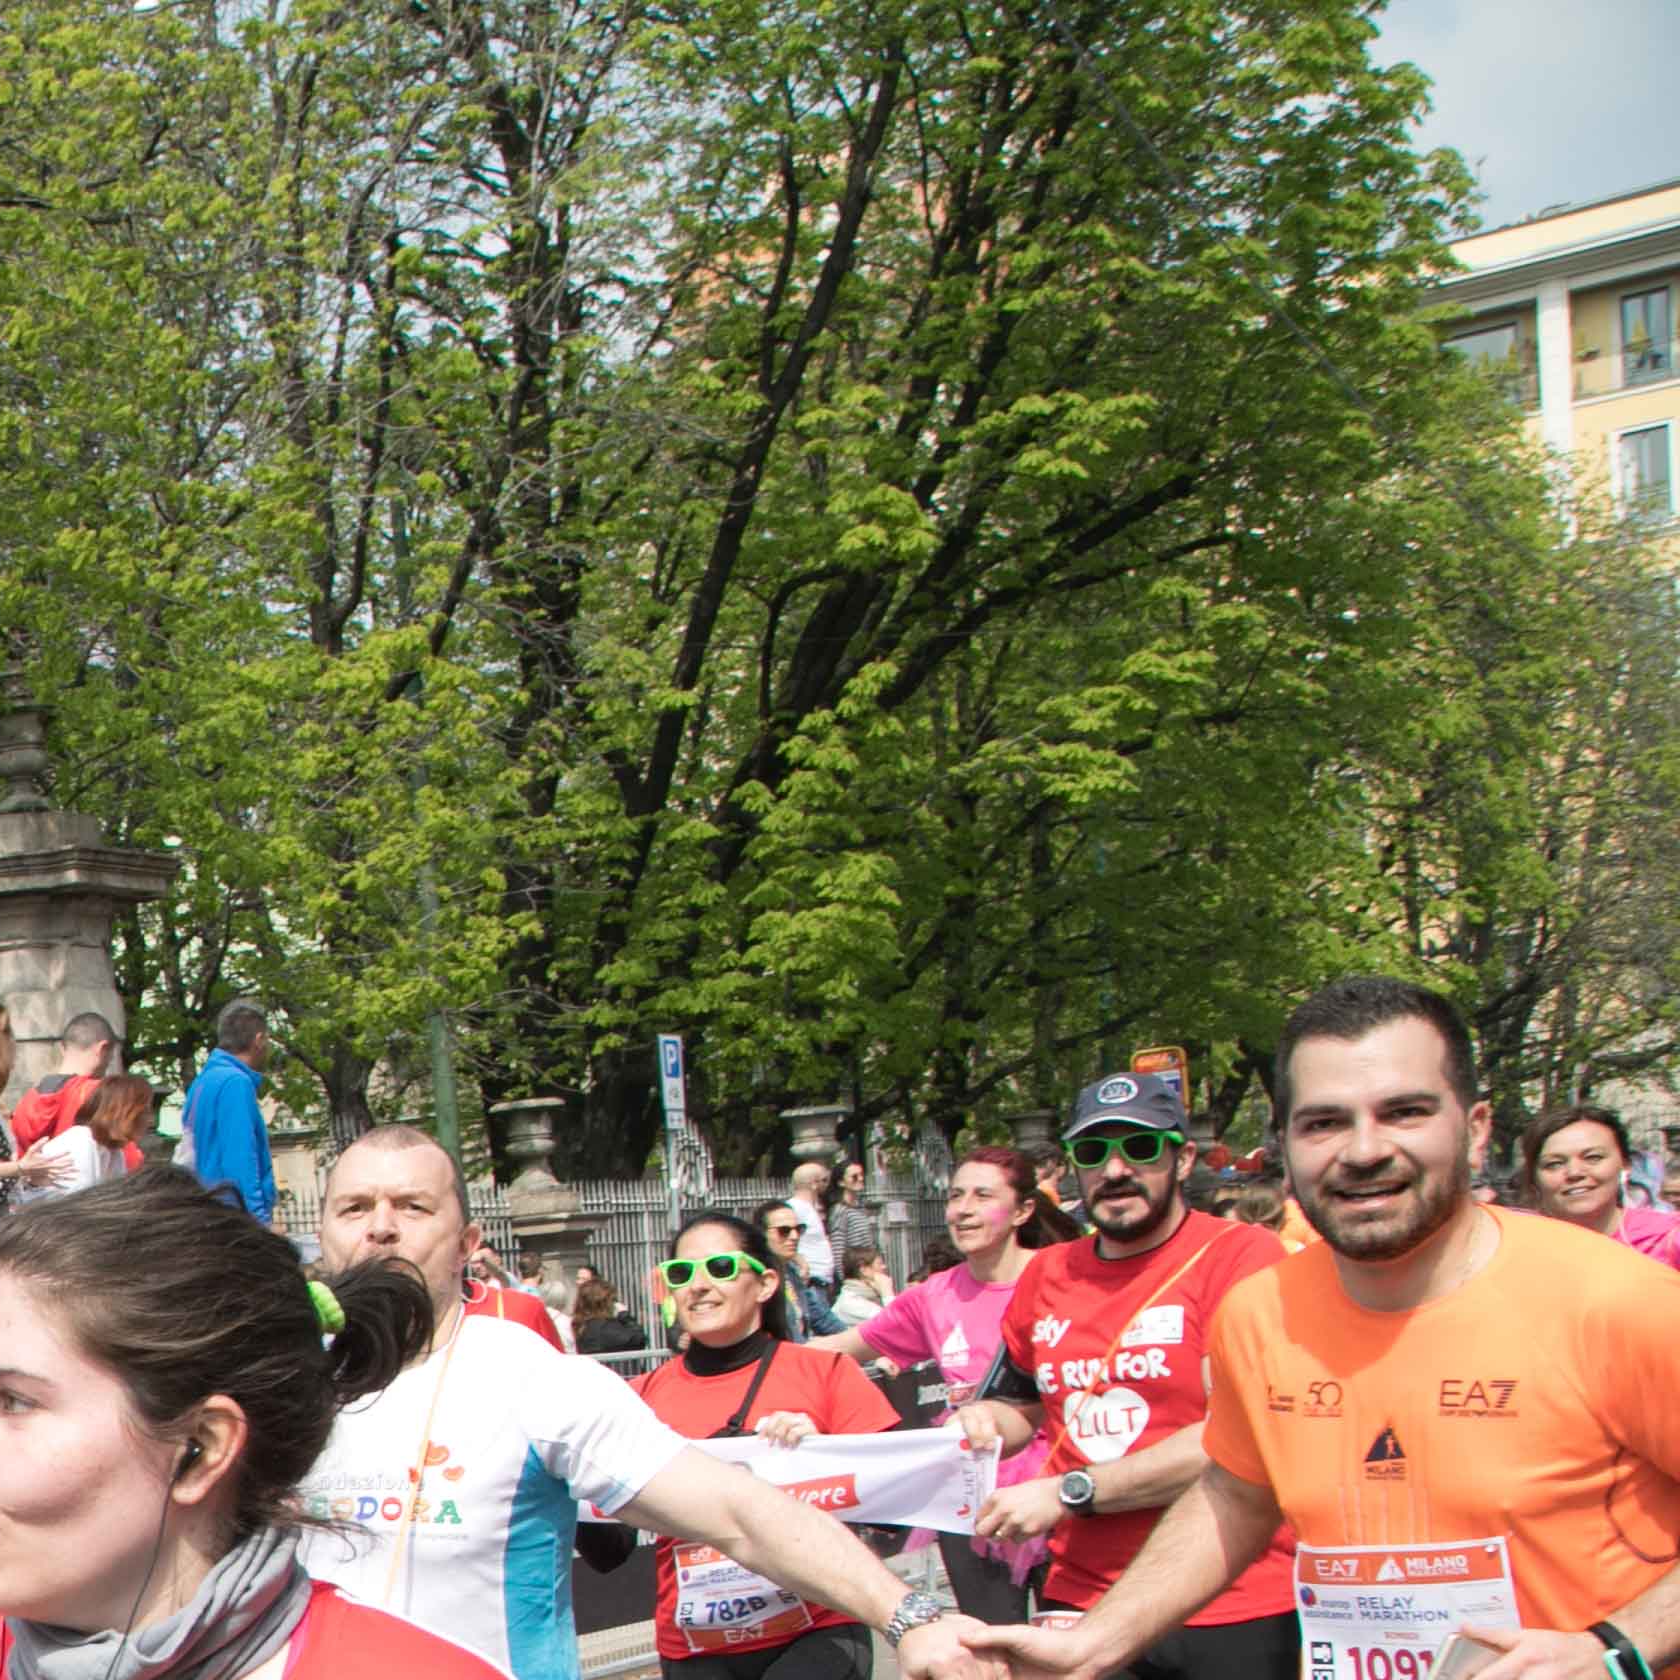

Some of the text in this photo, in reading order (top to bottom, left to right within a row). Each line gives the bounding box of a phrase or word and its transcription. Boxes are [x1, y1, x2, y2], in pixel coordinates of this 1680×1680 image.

[1032, 1314, 1071, 1348] sky
[1115, 1347, 1172, 1381] FOR
[1440, 1380, 1519, 1408] EA7
[1077, 1405, 1144, 1440] LILT
[1314, 1555, 1468, 1577] EA7 MILANO
[1357, 1595, 1414, 1610] RELAY
[1359, 1609, 1450, 1623] MARATHON
